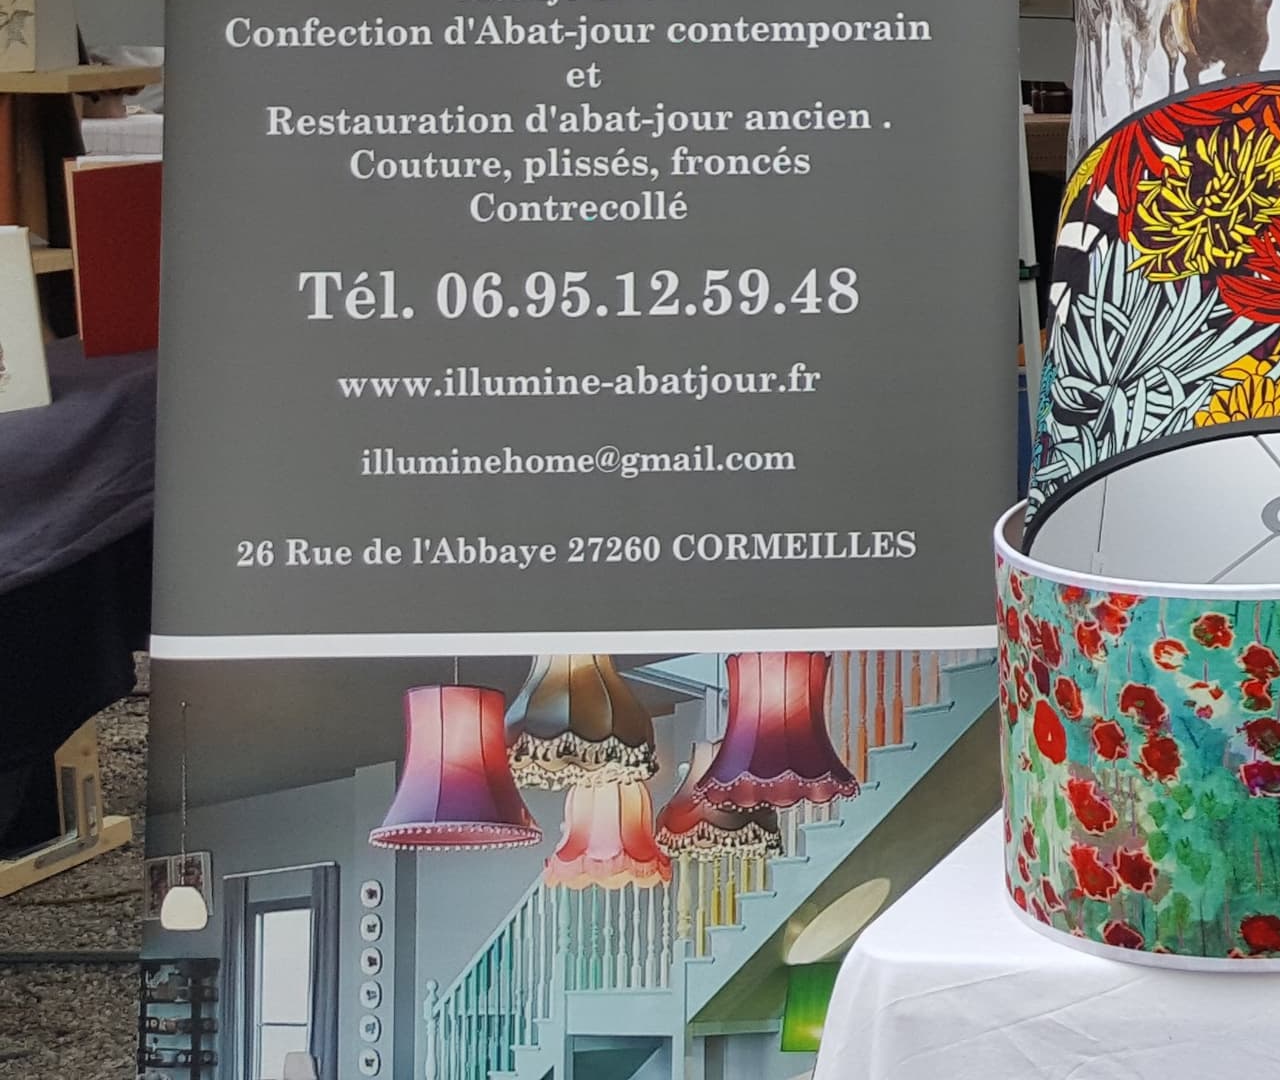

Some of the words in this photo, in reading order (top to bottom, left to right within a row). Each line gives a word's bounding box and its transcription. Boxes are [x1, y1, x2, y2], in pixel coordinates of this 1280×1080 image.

[225, 17, 433, 48] Confection
[444, 15, 655, 50] d'Abat-jour
[667, 12, 932, 49] contemporain
[566, 62, 602, 88] et
[266, 105, 514, 136] Restauration
[525, 102, 733, 138] d'abat-jour
[745, 101, 871, 131] ancien
[350, 149, 512, 183] Couture,
[523, 147, 659, 184] plissés,
[670, 145, 811, 175] froncés
[470, 190, 688, 222] Contrecollé
[298, 270, 414, 320] Tél.
[436, 267, 859, 319] 06.95.12.59.48
[337, 362, 821, 400] www.illumine-abatjour.fr
[361, 444, 796, 479] illuminehome@gmail.com
[236, 540, 274, 567] 26
[285, 538, 352, 566] Rue
[363, 538, 402, 565] de
[413, 536, 557, 570] l'Abbaye
[567, 536, 661, 562] 27260
[672, 530, 916, 561] CORMEILLES
